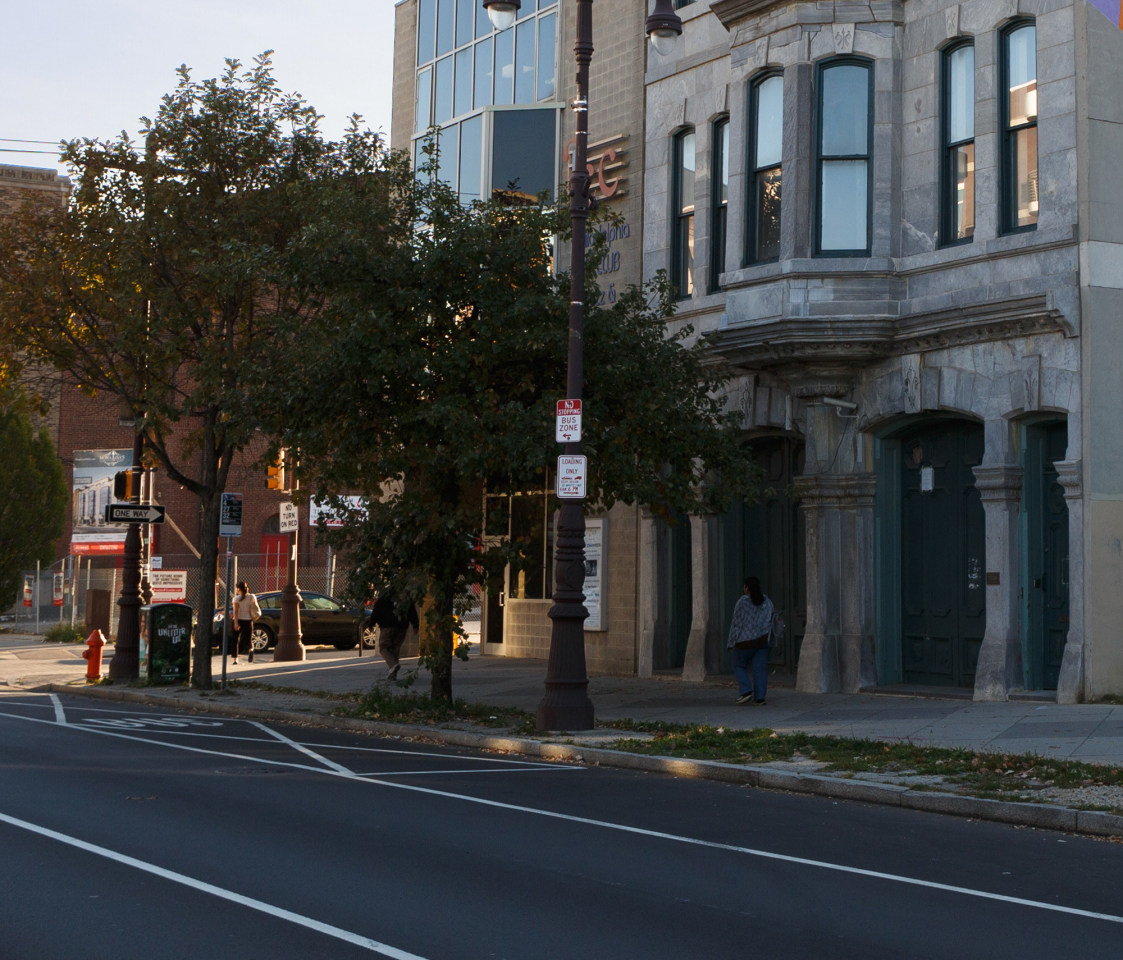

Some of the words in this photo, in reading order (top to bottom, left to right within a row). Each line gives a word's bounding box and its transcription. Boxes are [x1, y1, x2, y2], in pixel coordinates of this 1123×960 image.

[285, 503, 293, 511] NO
[282, 512, 296, 520] TURN
[288, 519, 298, 527] RED
